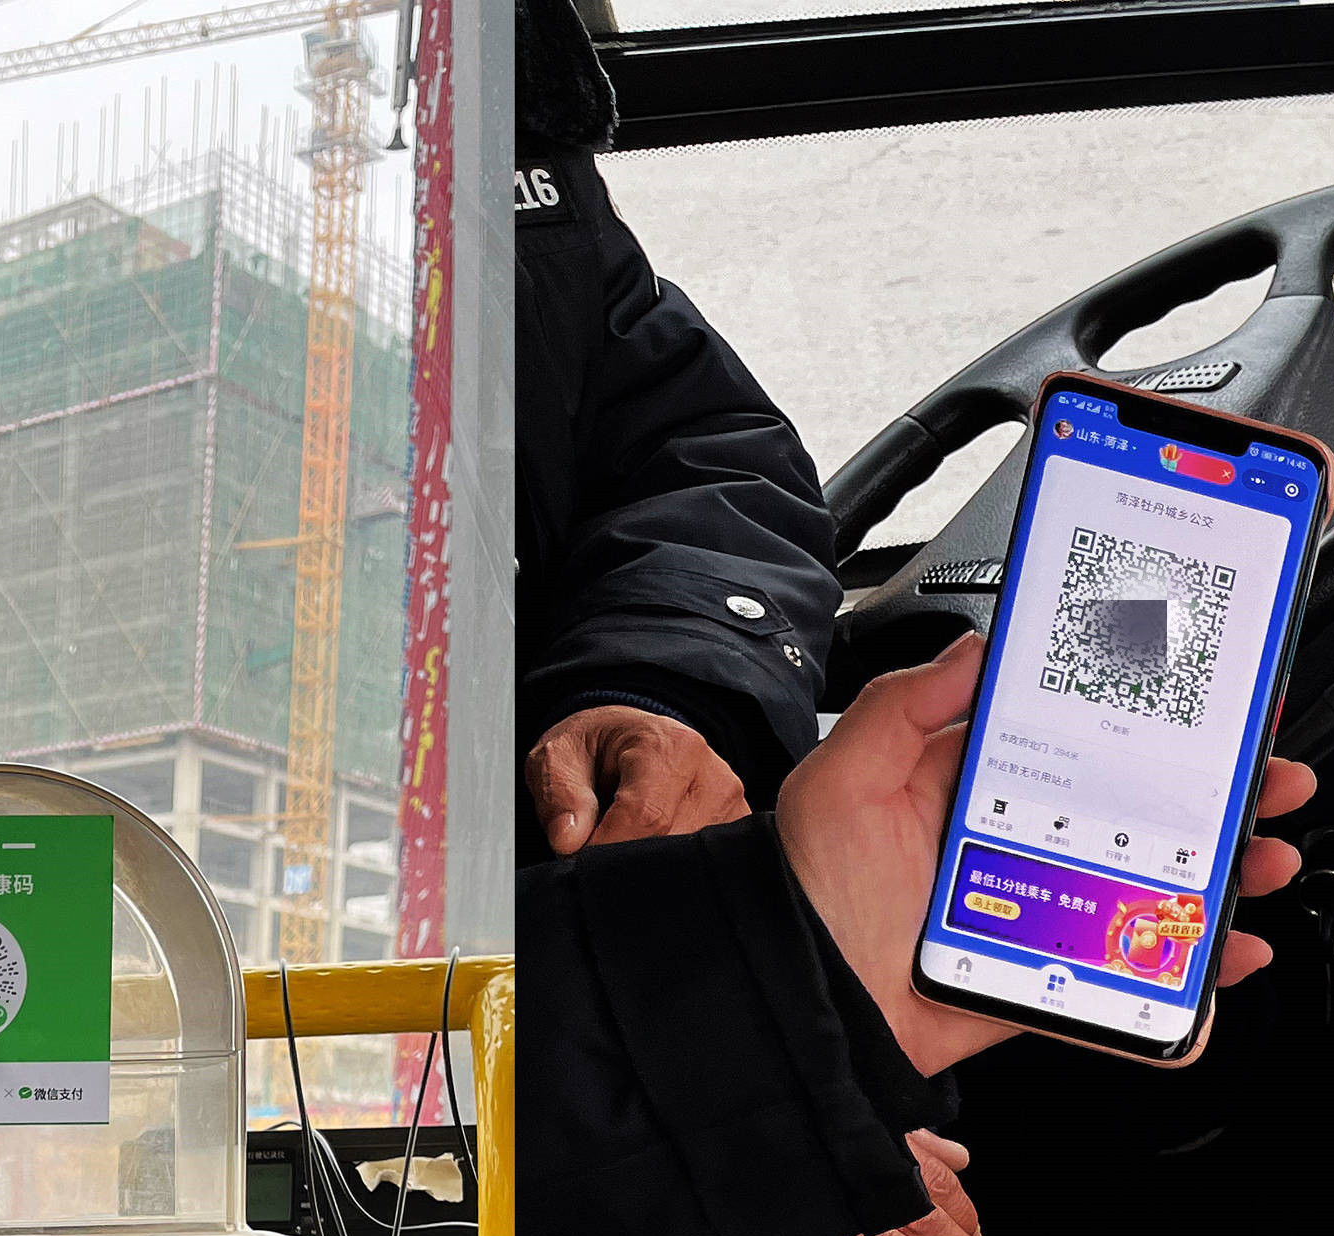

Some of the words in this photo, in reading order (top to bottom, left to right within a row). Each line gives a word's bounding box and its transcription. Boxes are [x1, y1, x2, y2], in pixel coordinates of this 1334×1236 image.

[515, 168, 560, 210] 16
[1115, 491, 1215, 529] 菏泽牡丹城乡公交
[986, 756, 1074, 790] 附近暂无可用站点
[968, 869, 1053, 904] 最低1分钱乘车
[1058, 892, 1098, 915] 免费领
[33, 1086, 84, 1102] 微信支付
